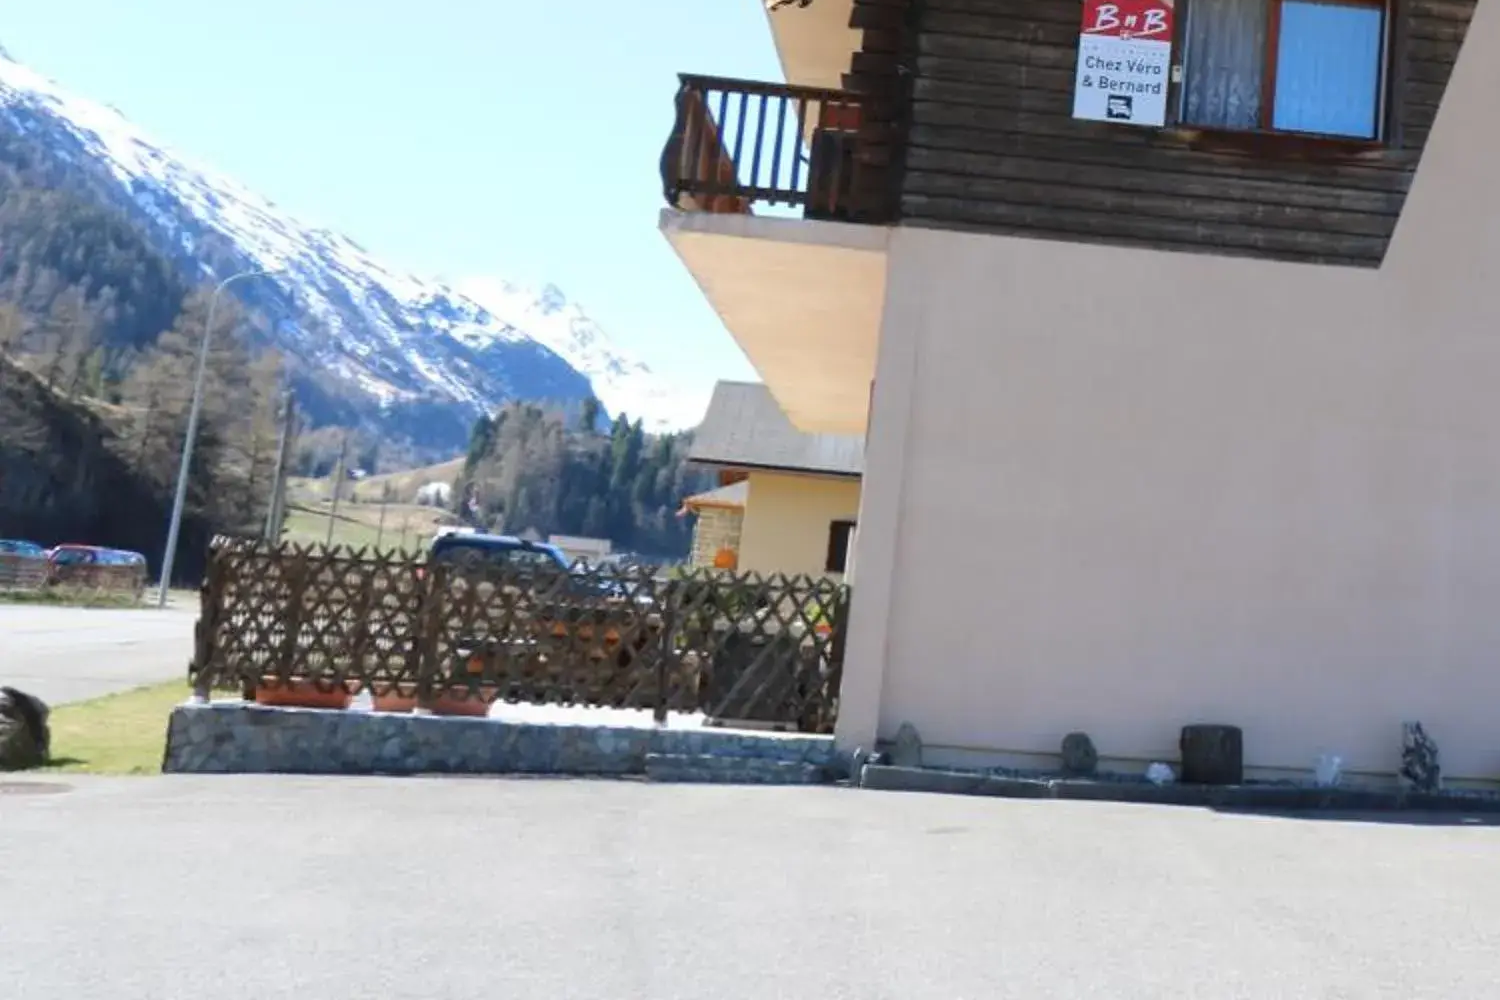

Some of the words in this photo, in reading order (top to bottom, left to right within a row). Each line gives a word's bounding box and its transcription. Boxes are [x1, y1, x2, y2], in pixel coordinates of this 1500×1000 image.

[1085, 56, 1123, 71] Chez
[1127, 59, 1161, 75] Véro
[1082, 75, 1092, 87] &
[1098, 76, 1162, 94] Bernard
